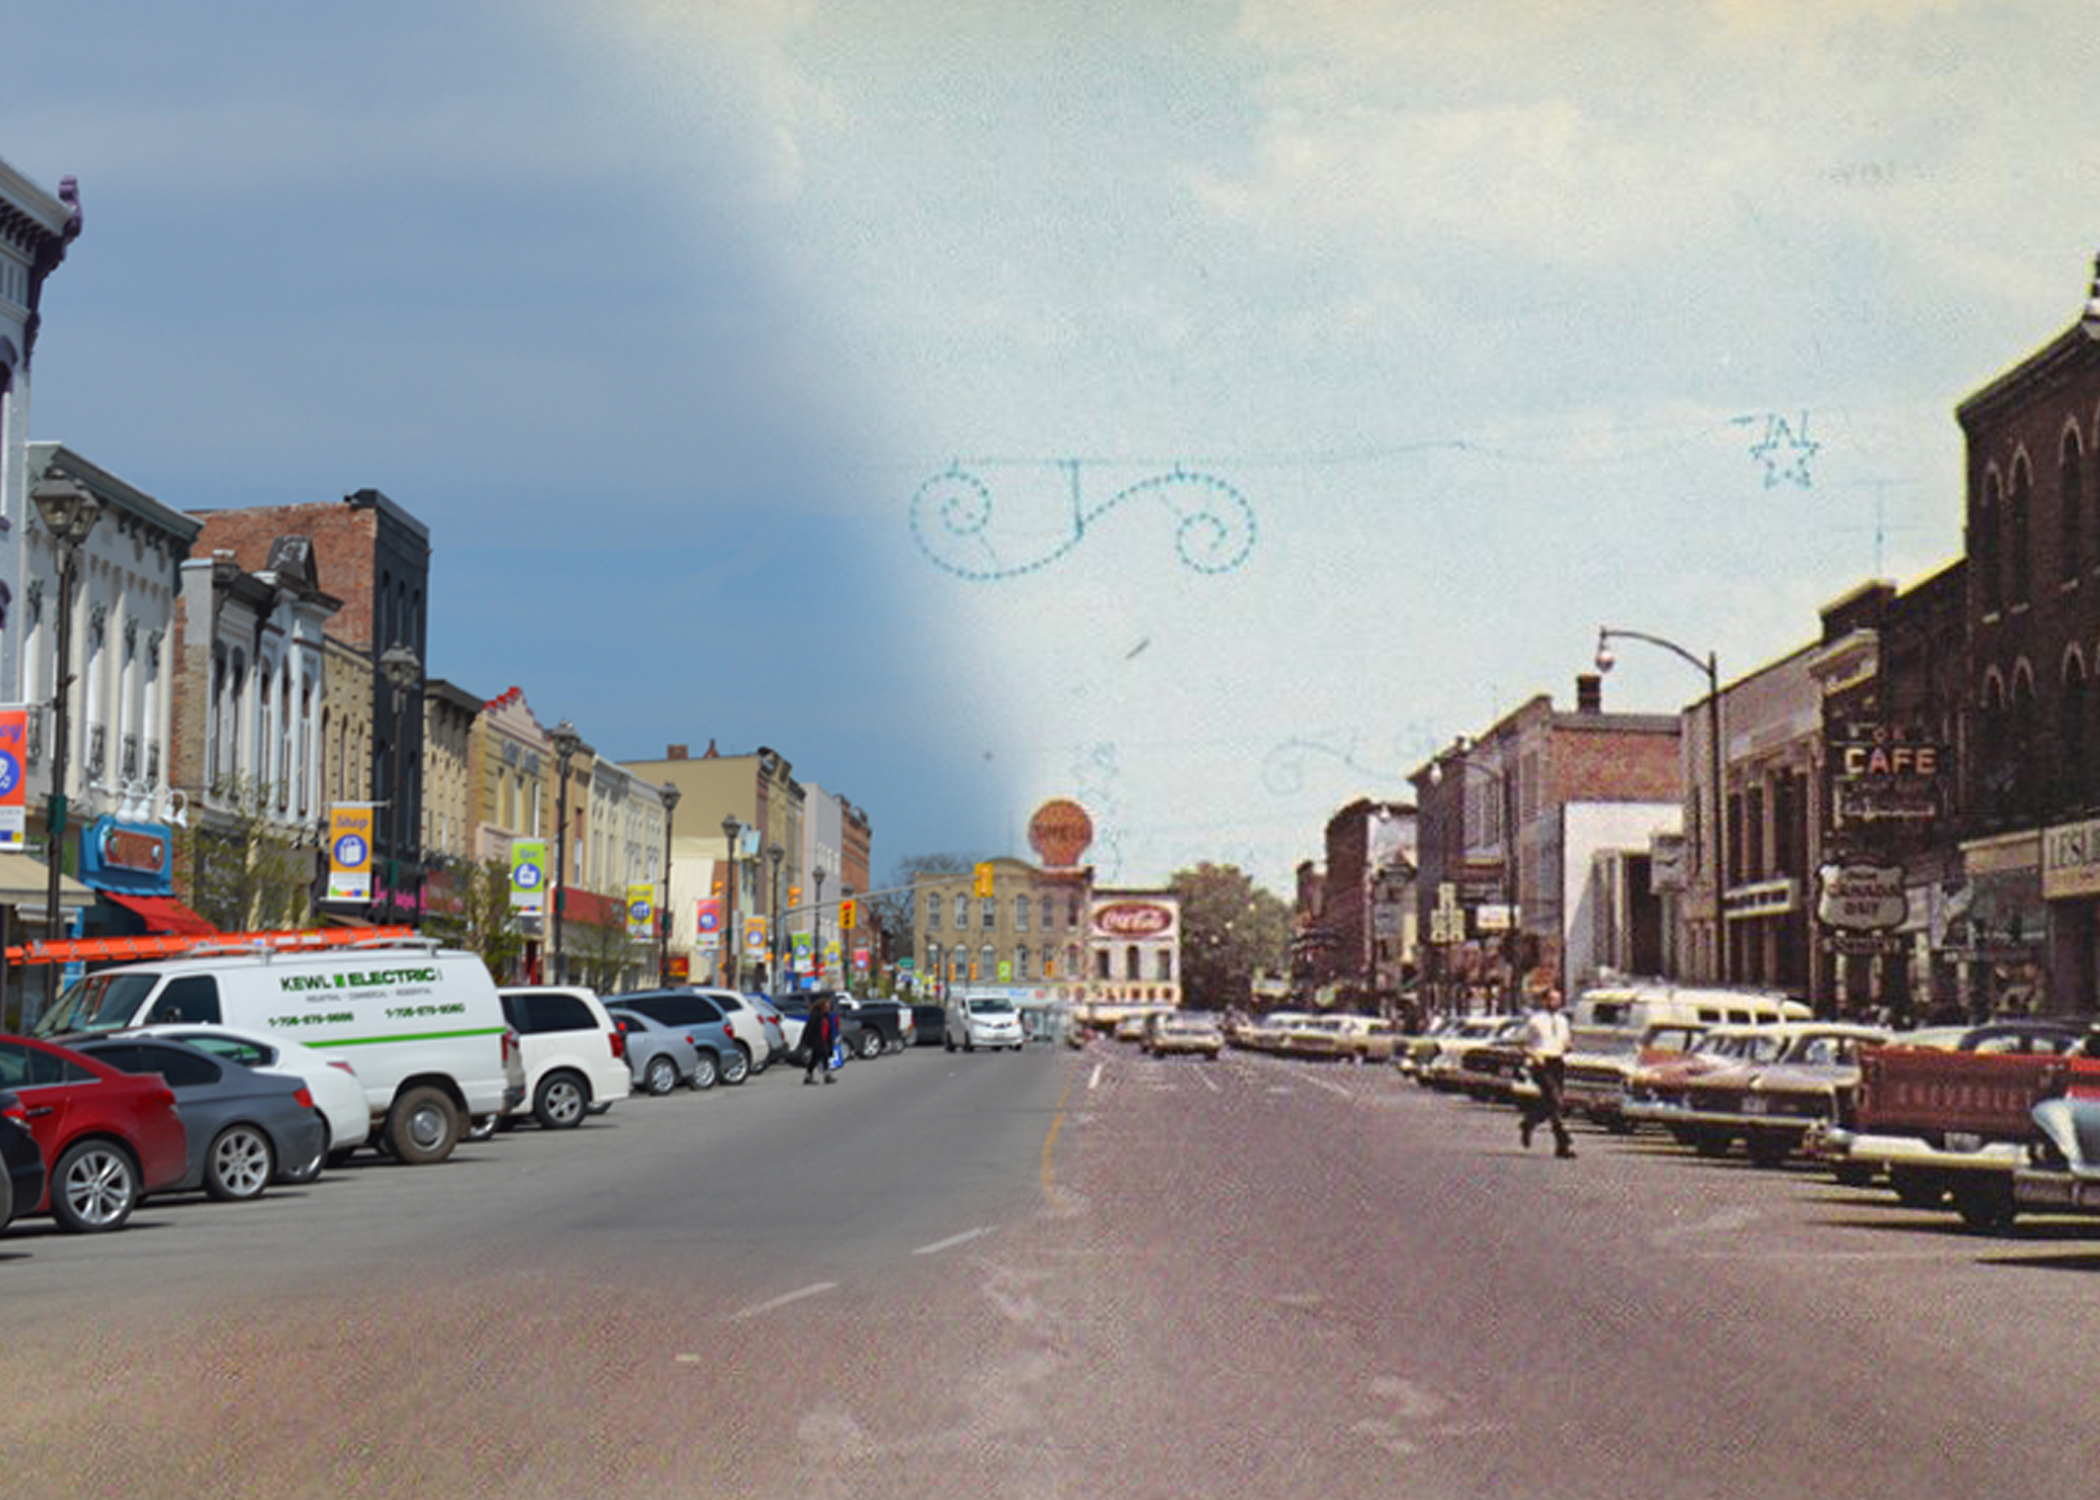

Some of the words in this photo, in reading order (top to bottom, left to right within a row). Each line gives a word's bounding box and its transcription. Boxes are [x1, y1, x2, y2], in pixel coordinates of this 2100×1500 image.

[0, 722, 23, 744] oy
[1845, 747, 1936, 775] CAFE
[335, 814, 369, 831] Shop
[280, 974, 332, 992] KEWL
[347, 967, 437, 988] ELECTRIC
